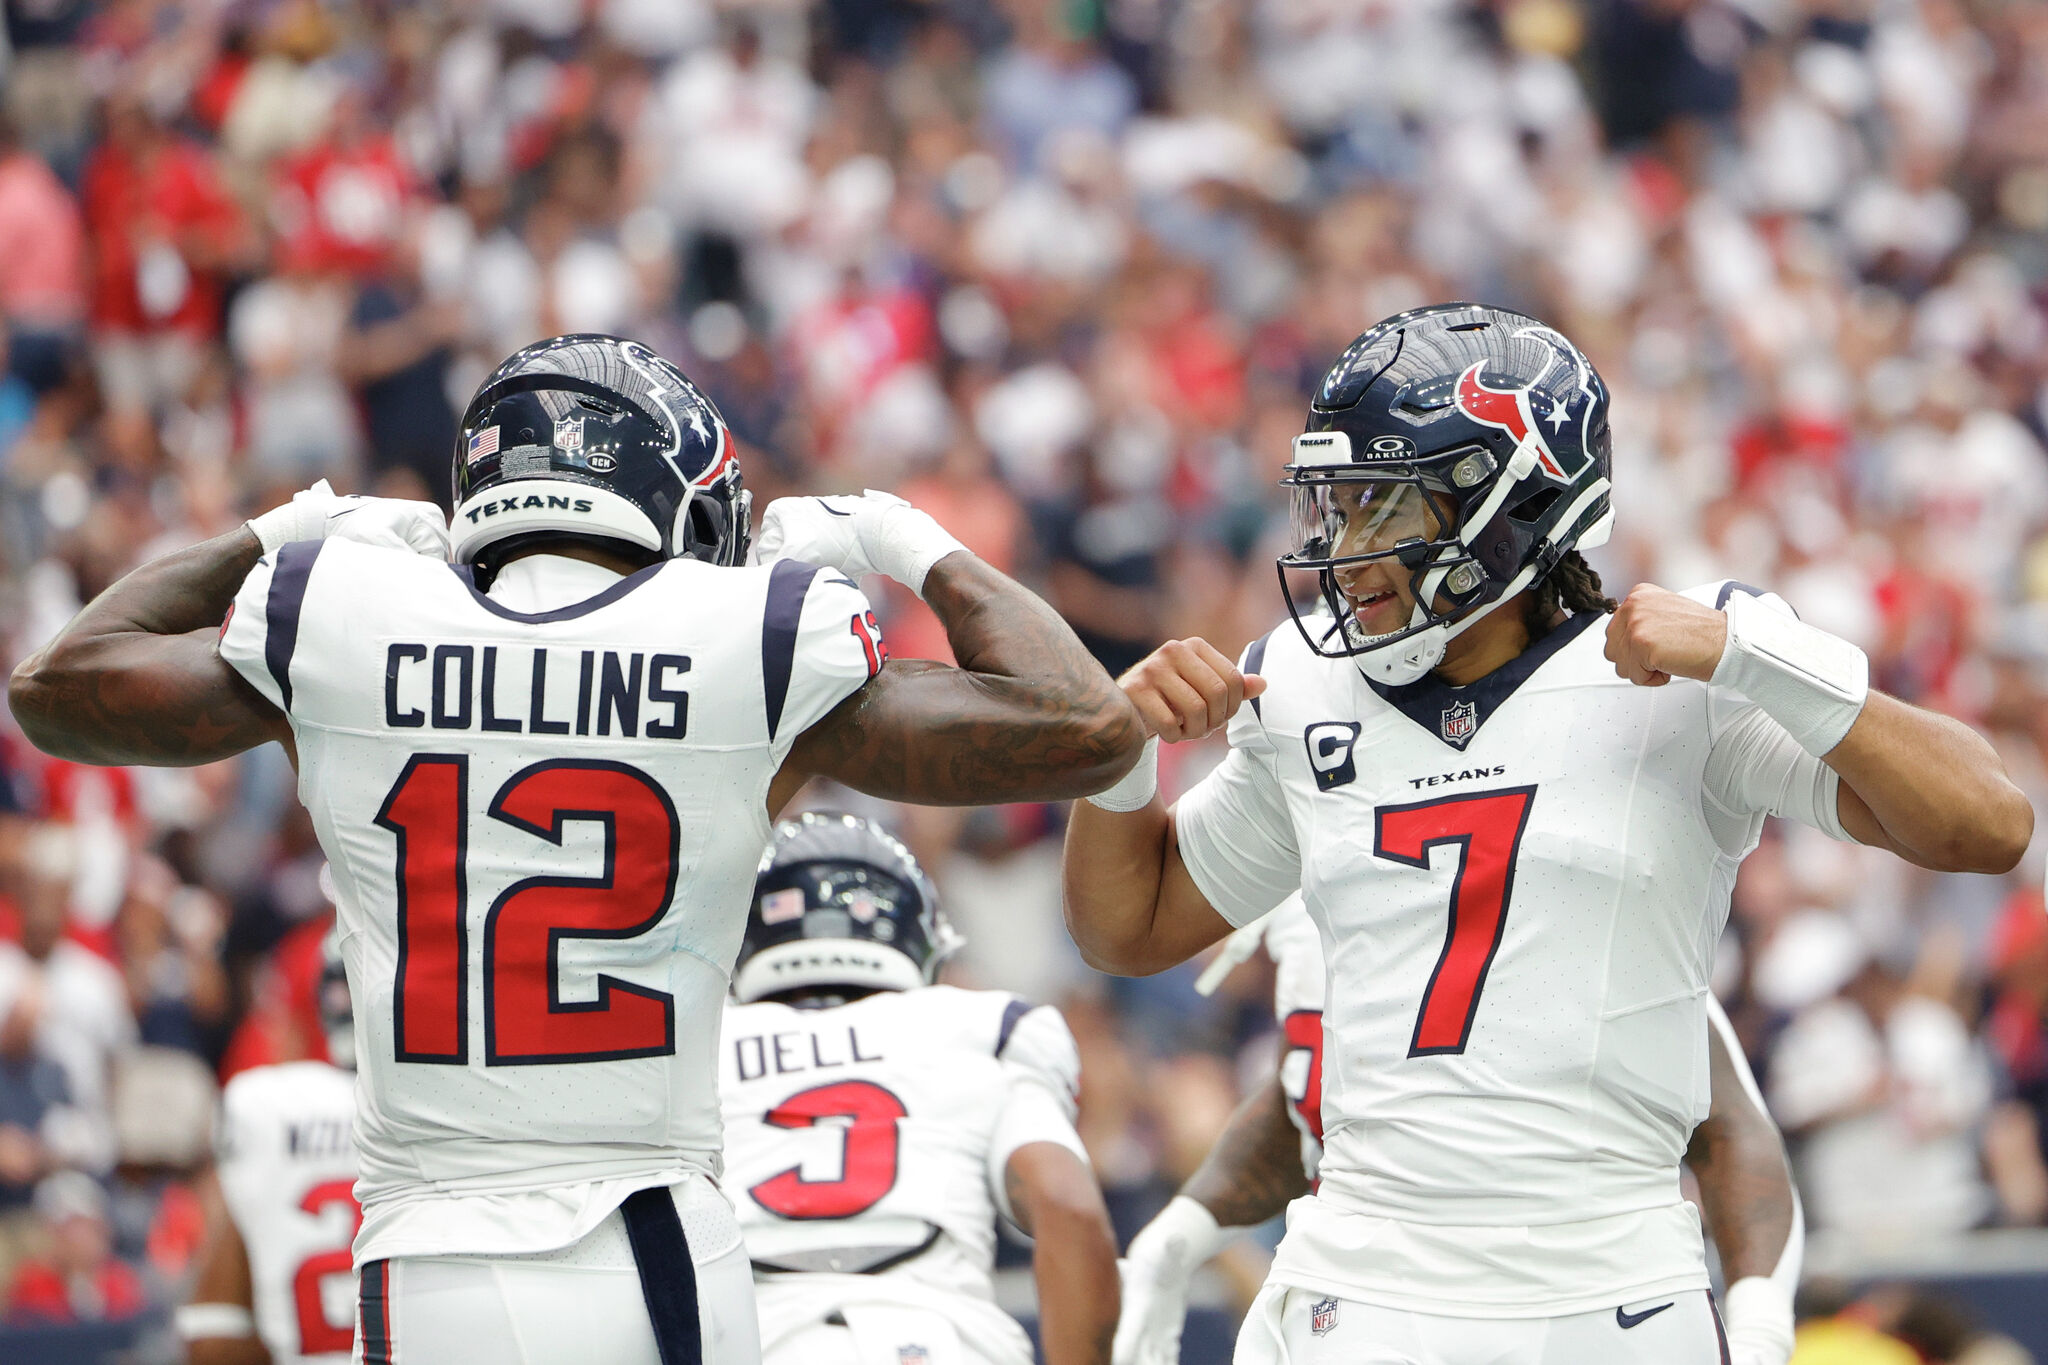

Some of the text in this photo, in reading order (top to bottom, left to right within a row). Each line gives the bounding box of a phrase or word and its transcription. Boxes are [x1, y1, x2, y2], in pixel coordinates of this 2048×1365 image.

[558, 433, 579, 447] NFL
[1366, 450, 1414, 460] OAKLEY
[465, 495, 594, 524] TEXANS
[385, 643, 692, 740] COLLINS
[1447, 717, 1471, 735] NFL
[1308, 725, 1354, 772] C
[1408, 765, 1506, 790] TEXANS
[373, 752, 681, 1067] 12
[1373, 784, 1539, 1060] 7
[734, 1027, 884, 1082] DELL
[748, 1079, 909, 1221] 3
[1314, 1312, 1334, 1329] NFL
